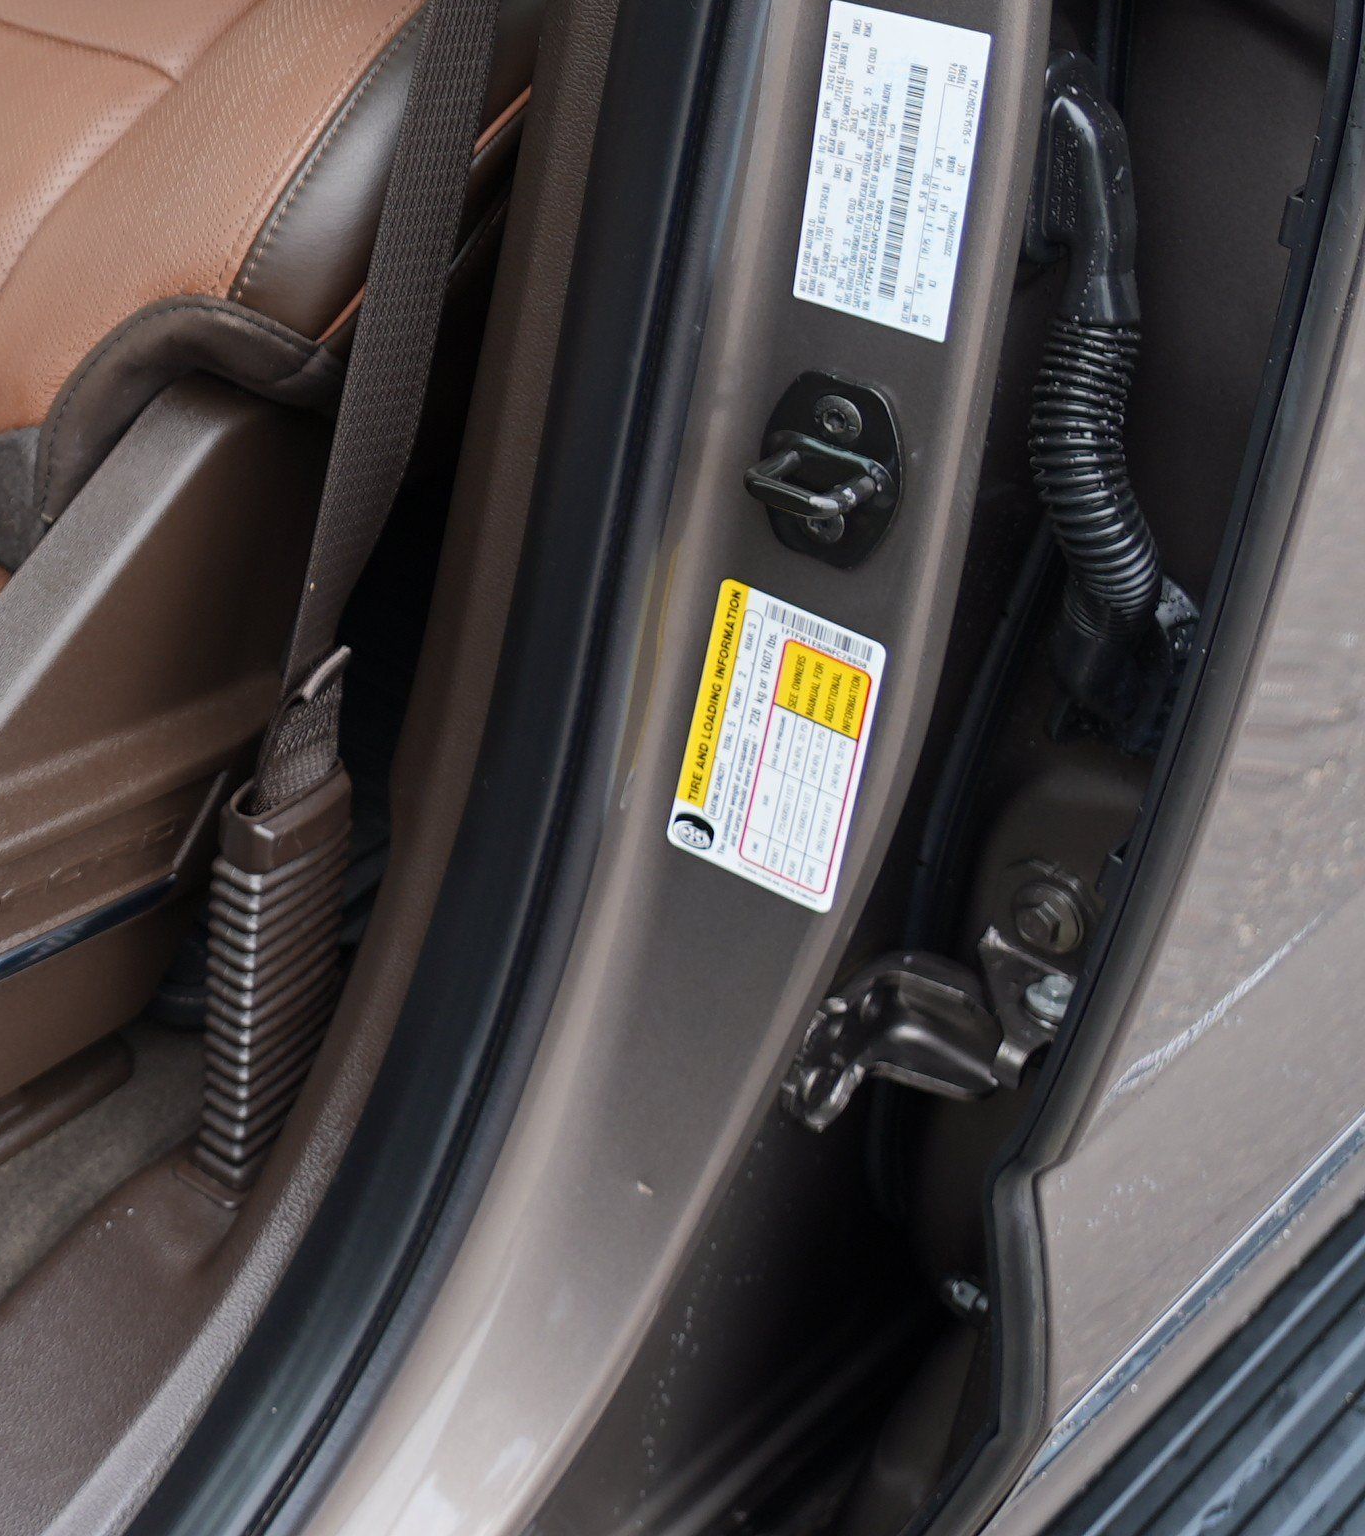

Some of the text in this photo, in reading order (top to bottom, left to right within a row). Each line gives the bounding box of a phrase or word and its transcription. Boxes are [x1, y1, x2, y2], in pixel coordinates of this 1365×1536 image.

[867, 47, 878, 64] COLD
[869, 102, 880, 126] VEHICLE
[866, 127, 876, 150] MOTOR
[847, 197, 857, 214] COLD
[805, 228, 814, 249] MOTOR
[802, 250, 811, 267] FORD
[787, 655, 806, 709] SEE OWNERS
[805, 661, 824, 717] MANUAL FOR
[687, 589, 741, 800] TIRE AND LOADING INFORMATION
[754, 691, 767, 704] kg
[824, 673, 843, 723] ADDITIONAL
[841, 674, 861, 733] INFORMATION
